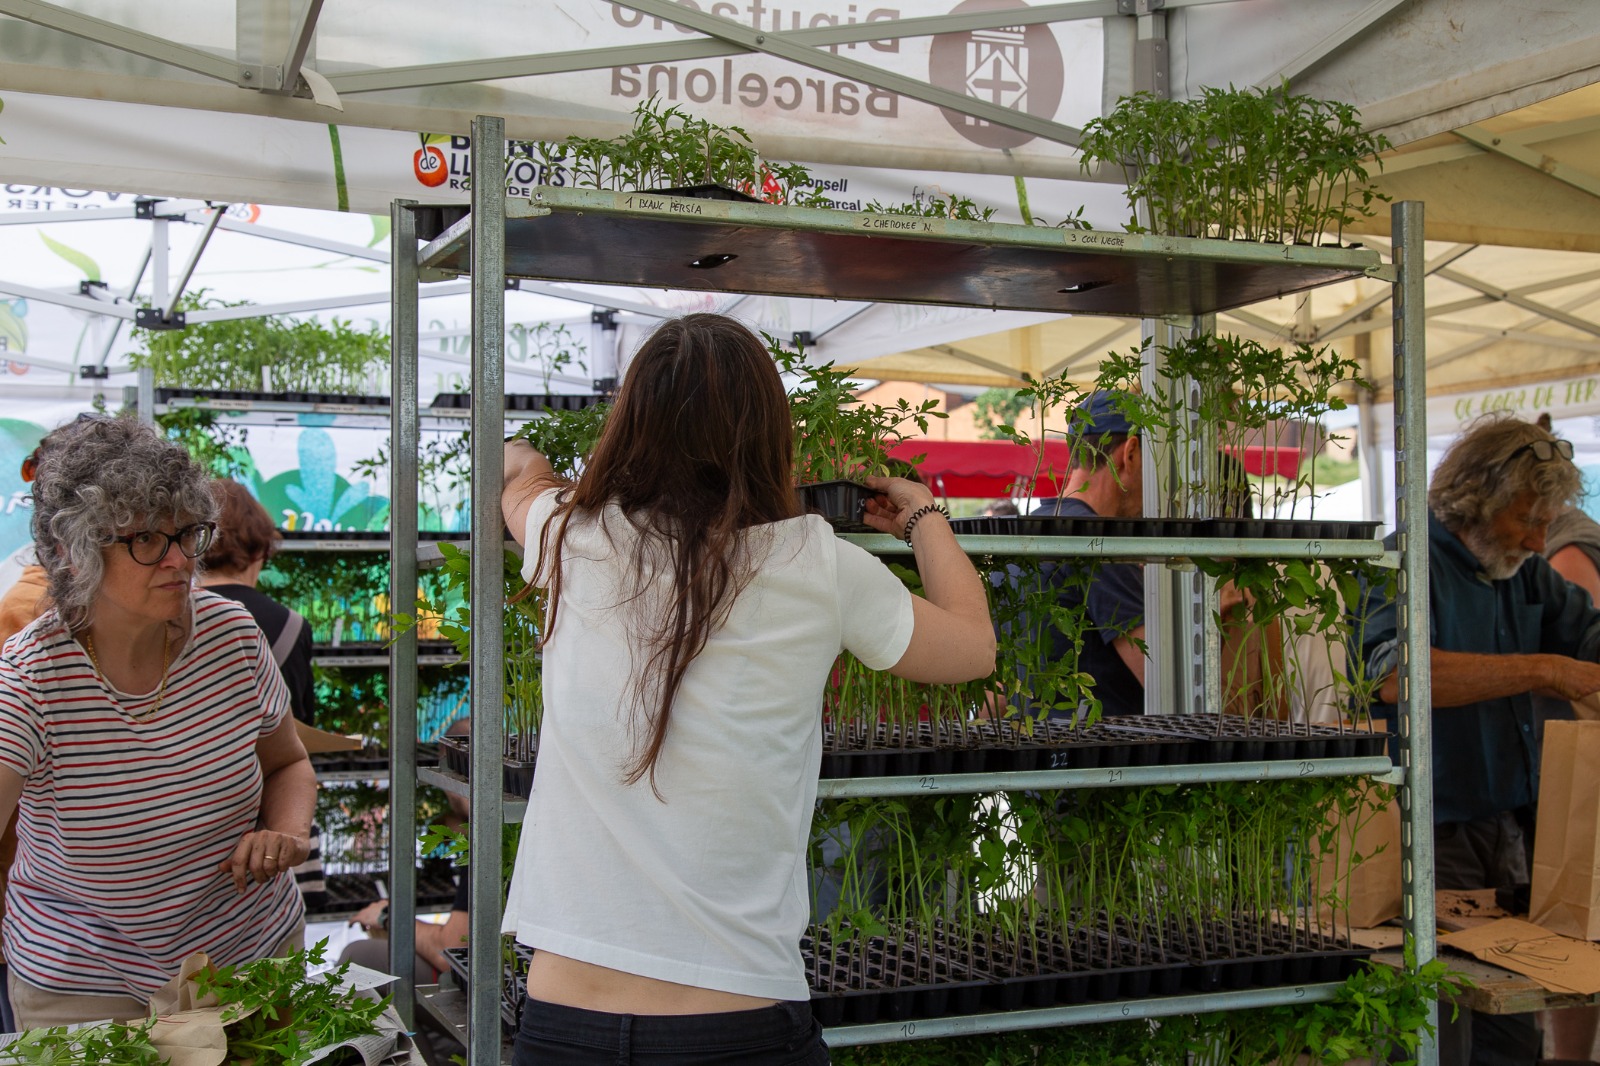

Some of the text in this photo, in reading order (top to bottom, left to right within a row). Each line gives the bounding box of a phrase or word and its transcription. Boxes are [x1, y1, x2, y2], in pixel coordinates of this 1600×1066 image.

[450, 152, 566, 187] LLORS
[508, 186, 531, 197] DE
[794, 177, 848, 193] onsell
[625, 196, 633, 209] 1
[639, 198, 665, 210] BLANC
[862, 217, 871, 228] 2
[873, 218, 917, 230] CHEROKEE
[1071, 233, 1077, 242] 3
[1100, 236, 1125, 247] NEGRE
[1086, 537, 1105, 554] 14
[1304, 540, 1322, 557] 15
[1050, 752, 1069, 768] 22
[1107, 769, 1123, 783] 21
[1298, 761, 1315, 777] 20
[918, 776, 940, 790] 22
[1294, 987, 1305, 998] 5
[1121, 1002, 1130, 1016] 6
[900, 1022, 916, 1038] 10
